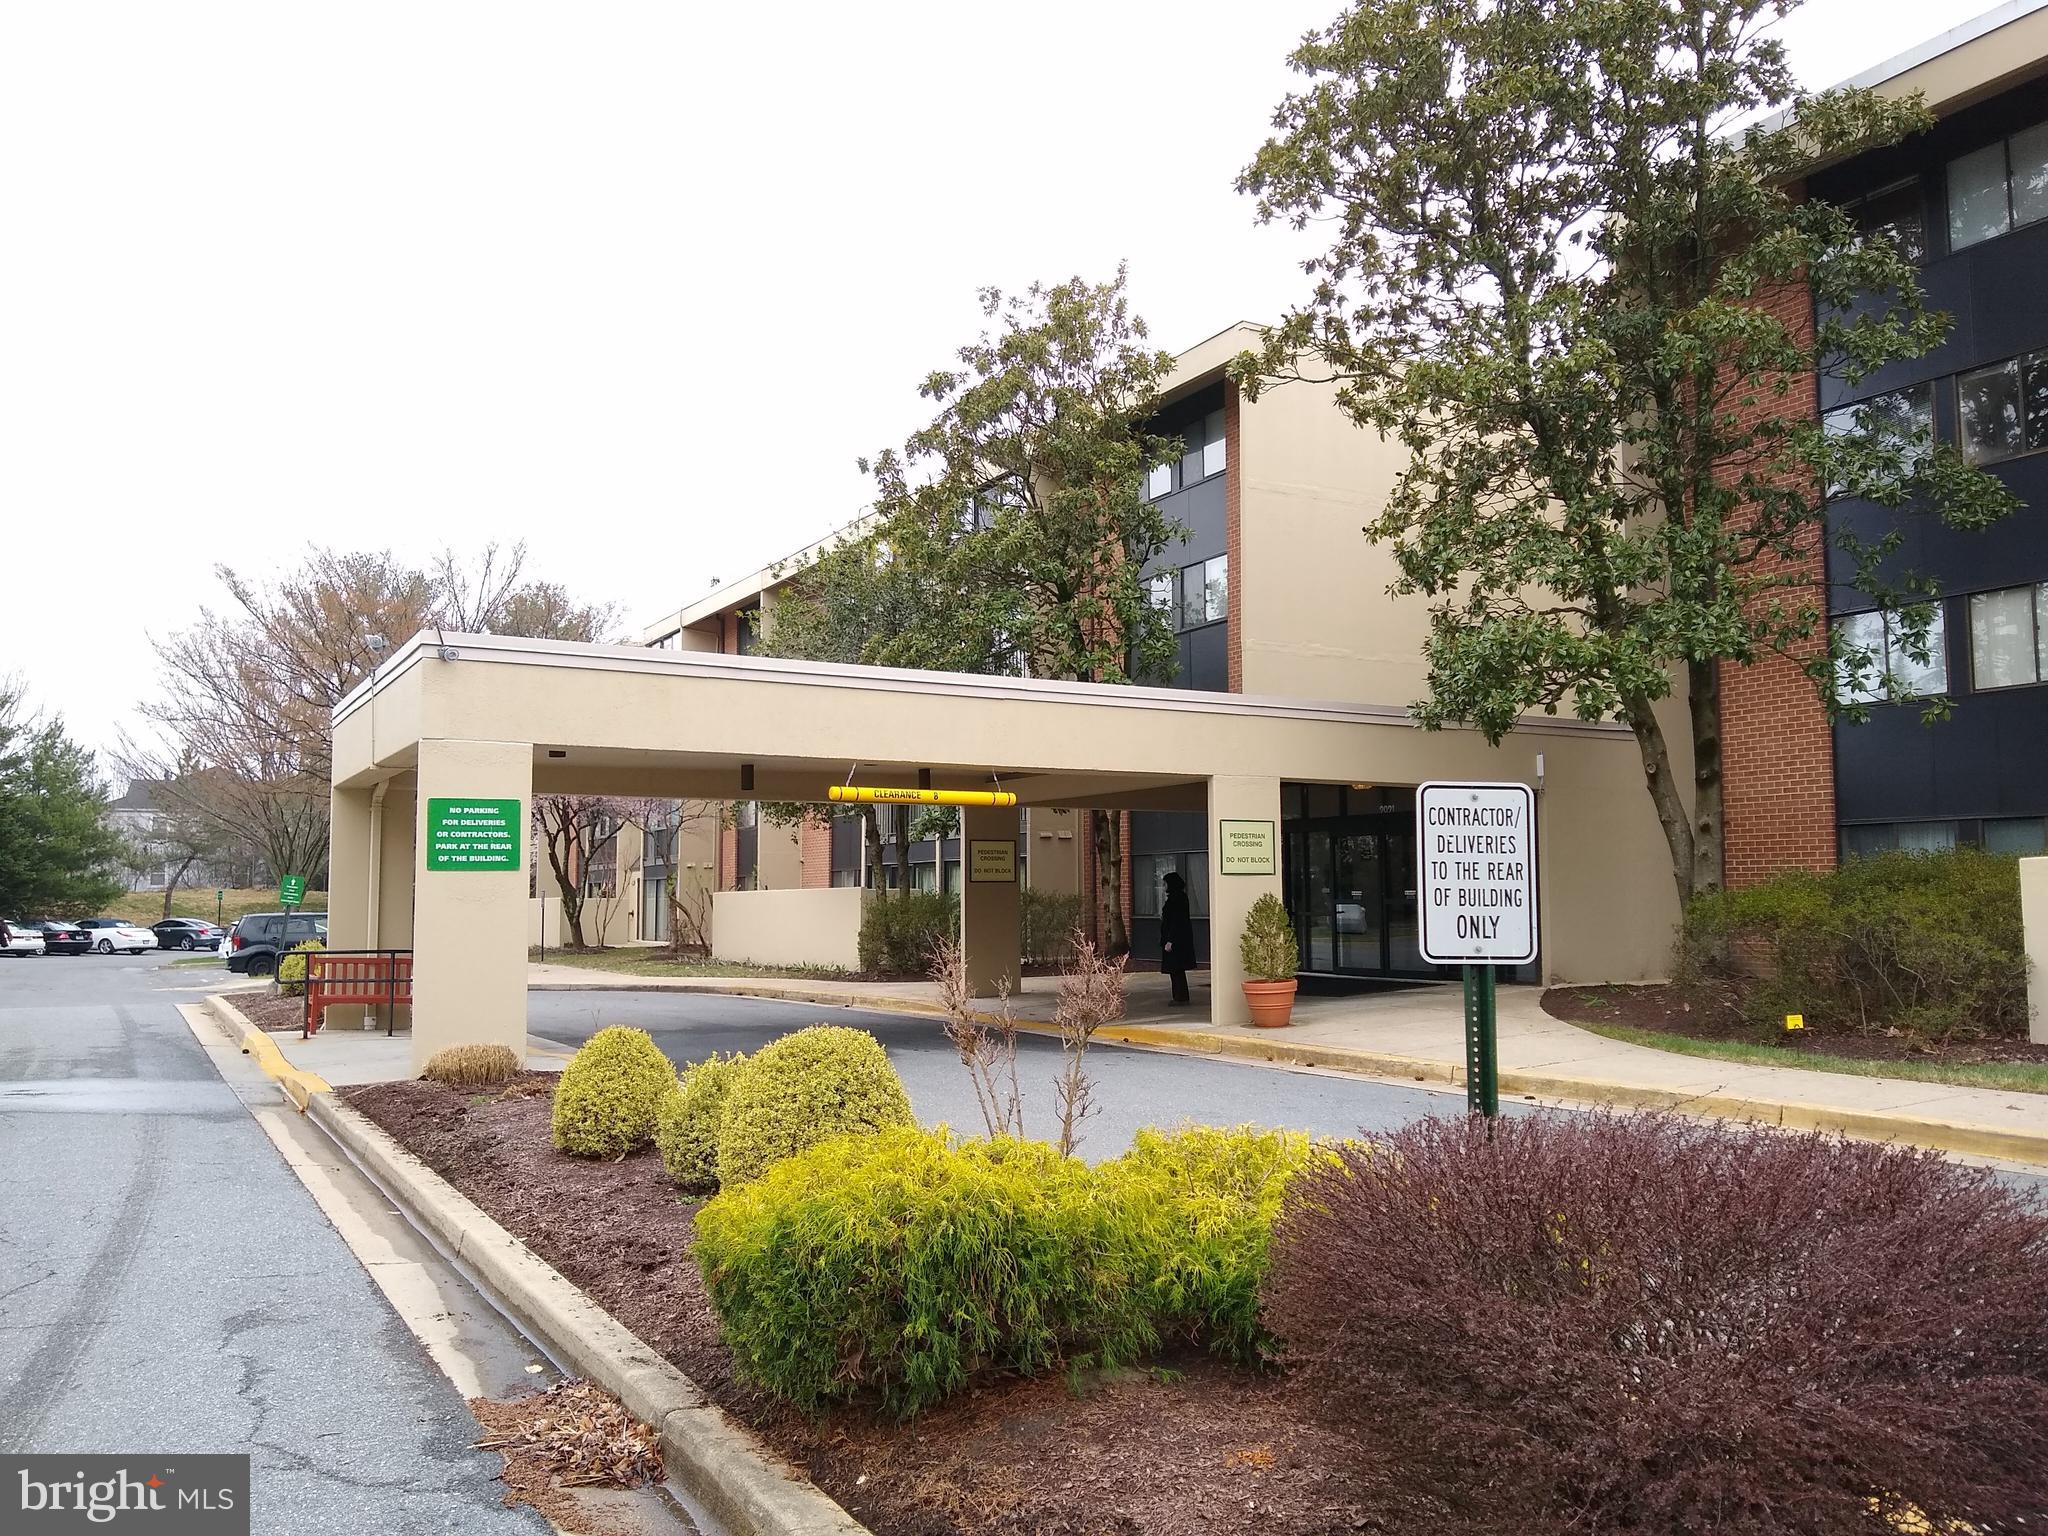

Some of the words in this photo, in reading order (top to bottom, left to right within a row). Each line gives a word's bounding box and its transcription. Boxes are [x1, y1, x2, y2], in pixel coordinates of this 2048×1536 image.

[874, 789, 921, 800] CLEARANCE
[1428, 806, 1521, 829] CONTRACTOR/
[1437, 834, 1517, 855] DELIVERIES
[1431, 861, 1448, 881] TO
[1455, 861, 1480, 881] THE
[1488, 862, 1524, 881] REAR
[1434, 887, 1451, 907] OF
[1458, 888, 1523, 908] BUILDING
[1456, 914, 1501, 940] ONLY
